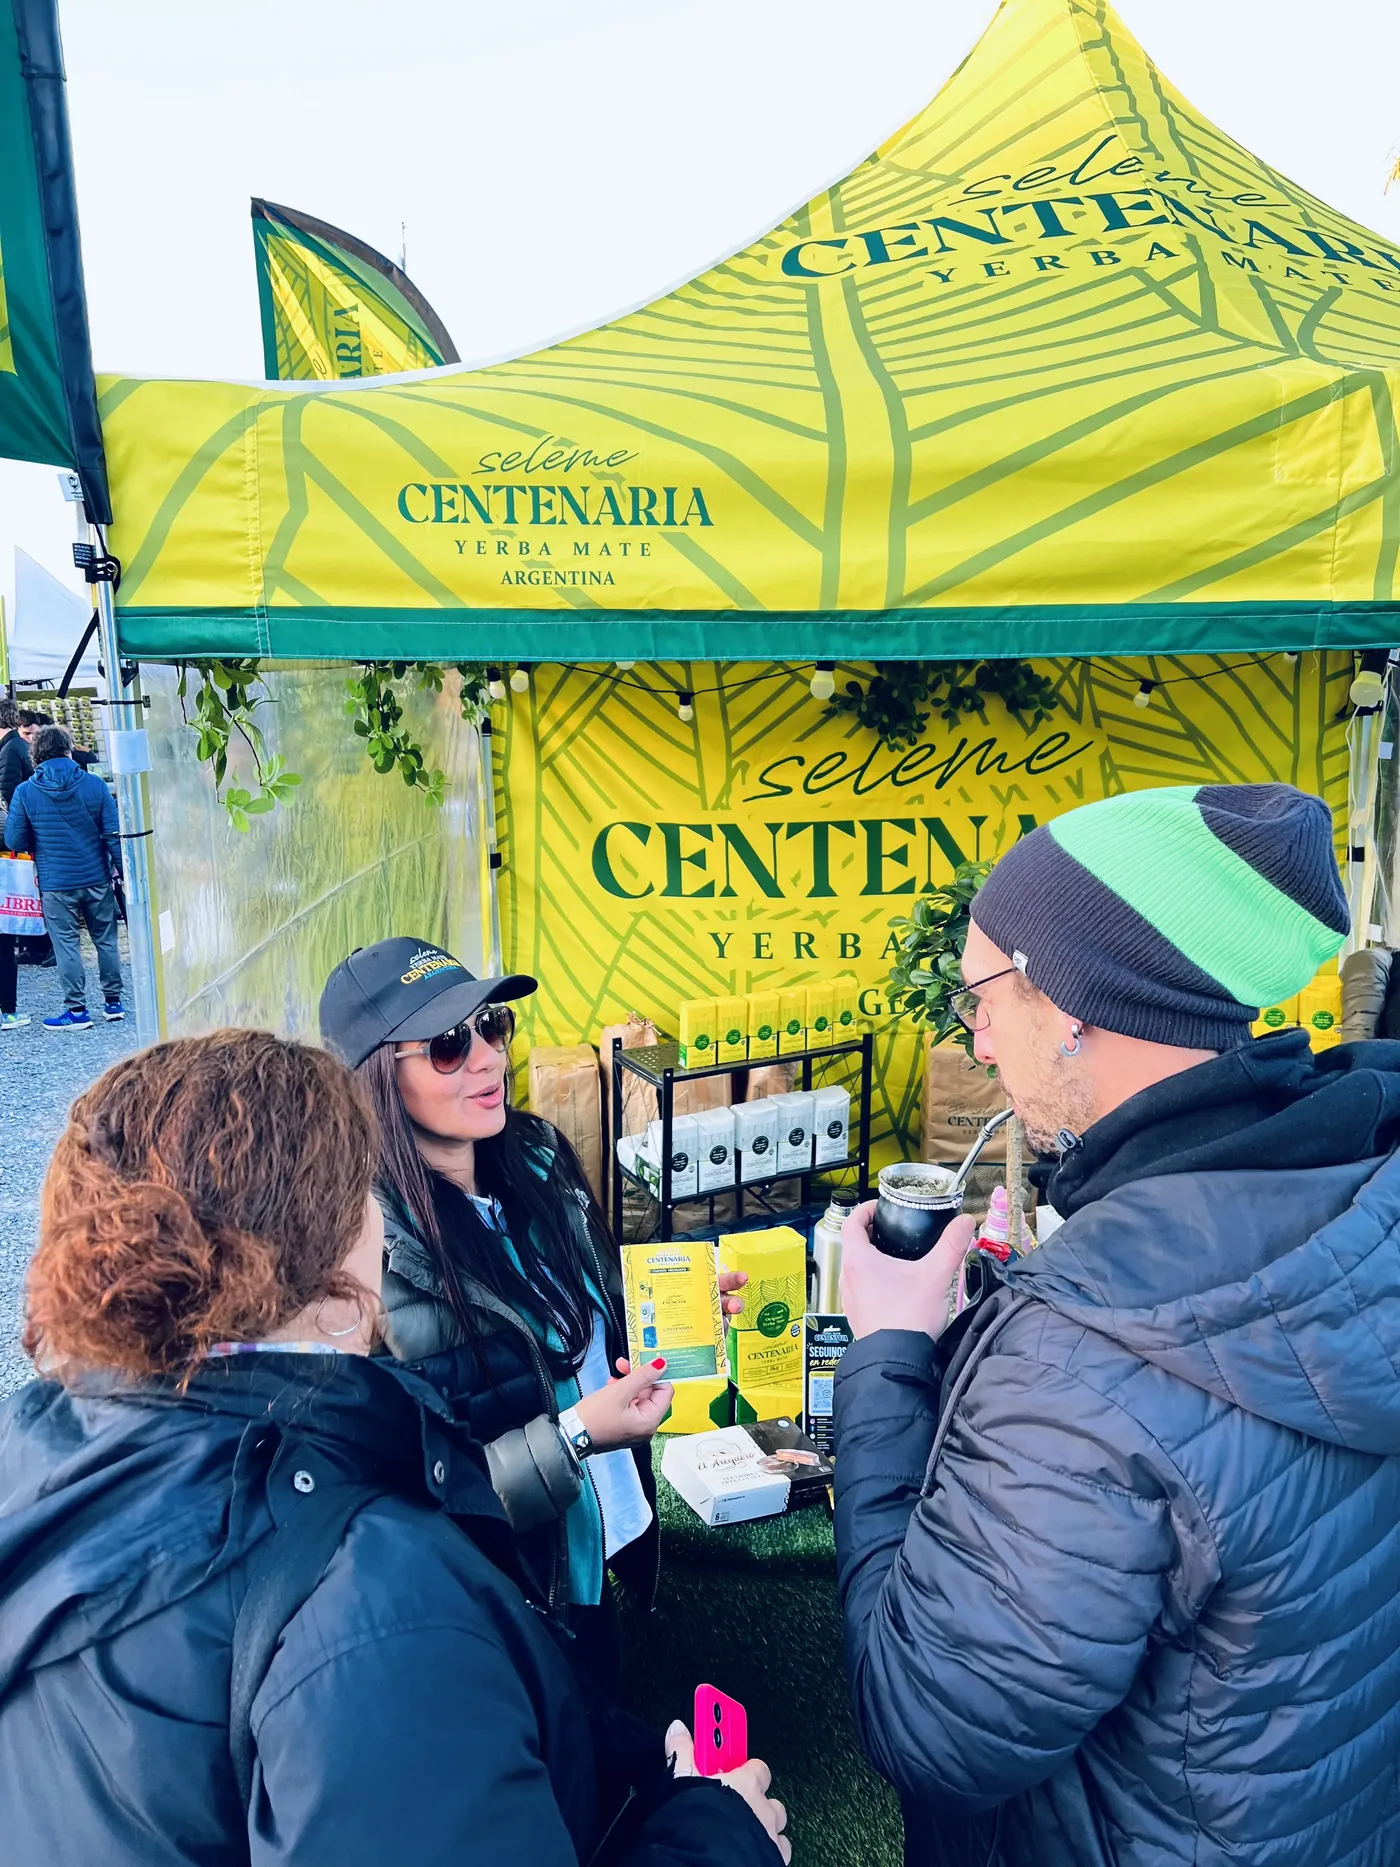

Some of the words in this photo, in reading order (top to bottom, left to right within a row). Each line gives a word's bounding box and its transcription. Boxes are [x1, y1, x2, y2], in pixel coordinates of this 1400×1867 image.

[926, 242, 1181, 284] YERBA
[471, 436, 640, 475] seleme
[397, 483, 715, 527] CENTENARIA
[454, 540, 552, 556] YERBA
[573, 542, 651, 557] MATE
[500, 570, 616, 586] ARGENTINA
[742, 731, 1094, 802] seleme
[591, 814, 1038, 899] CENTEN
[708, 931, 901, 960] YERBA
[646, 1256, 691, 1264] CENTENARIA
[747, 1344, 799, 1361] CENTENARIA
[809, 1346, 847, 1358] SEGUINOS
[809, 1359, 820, 1367] en
